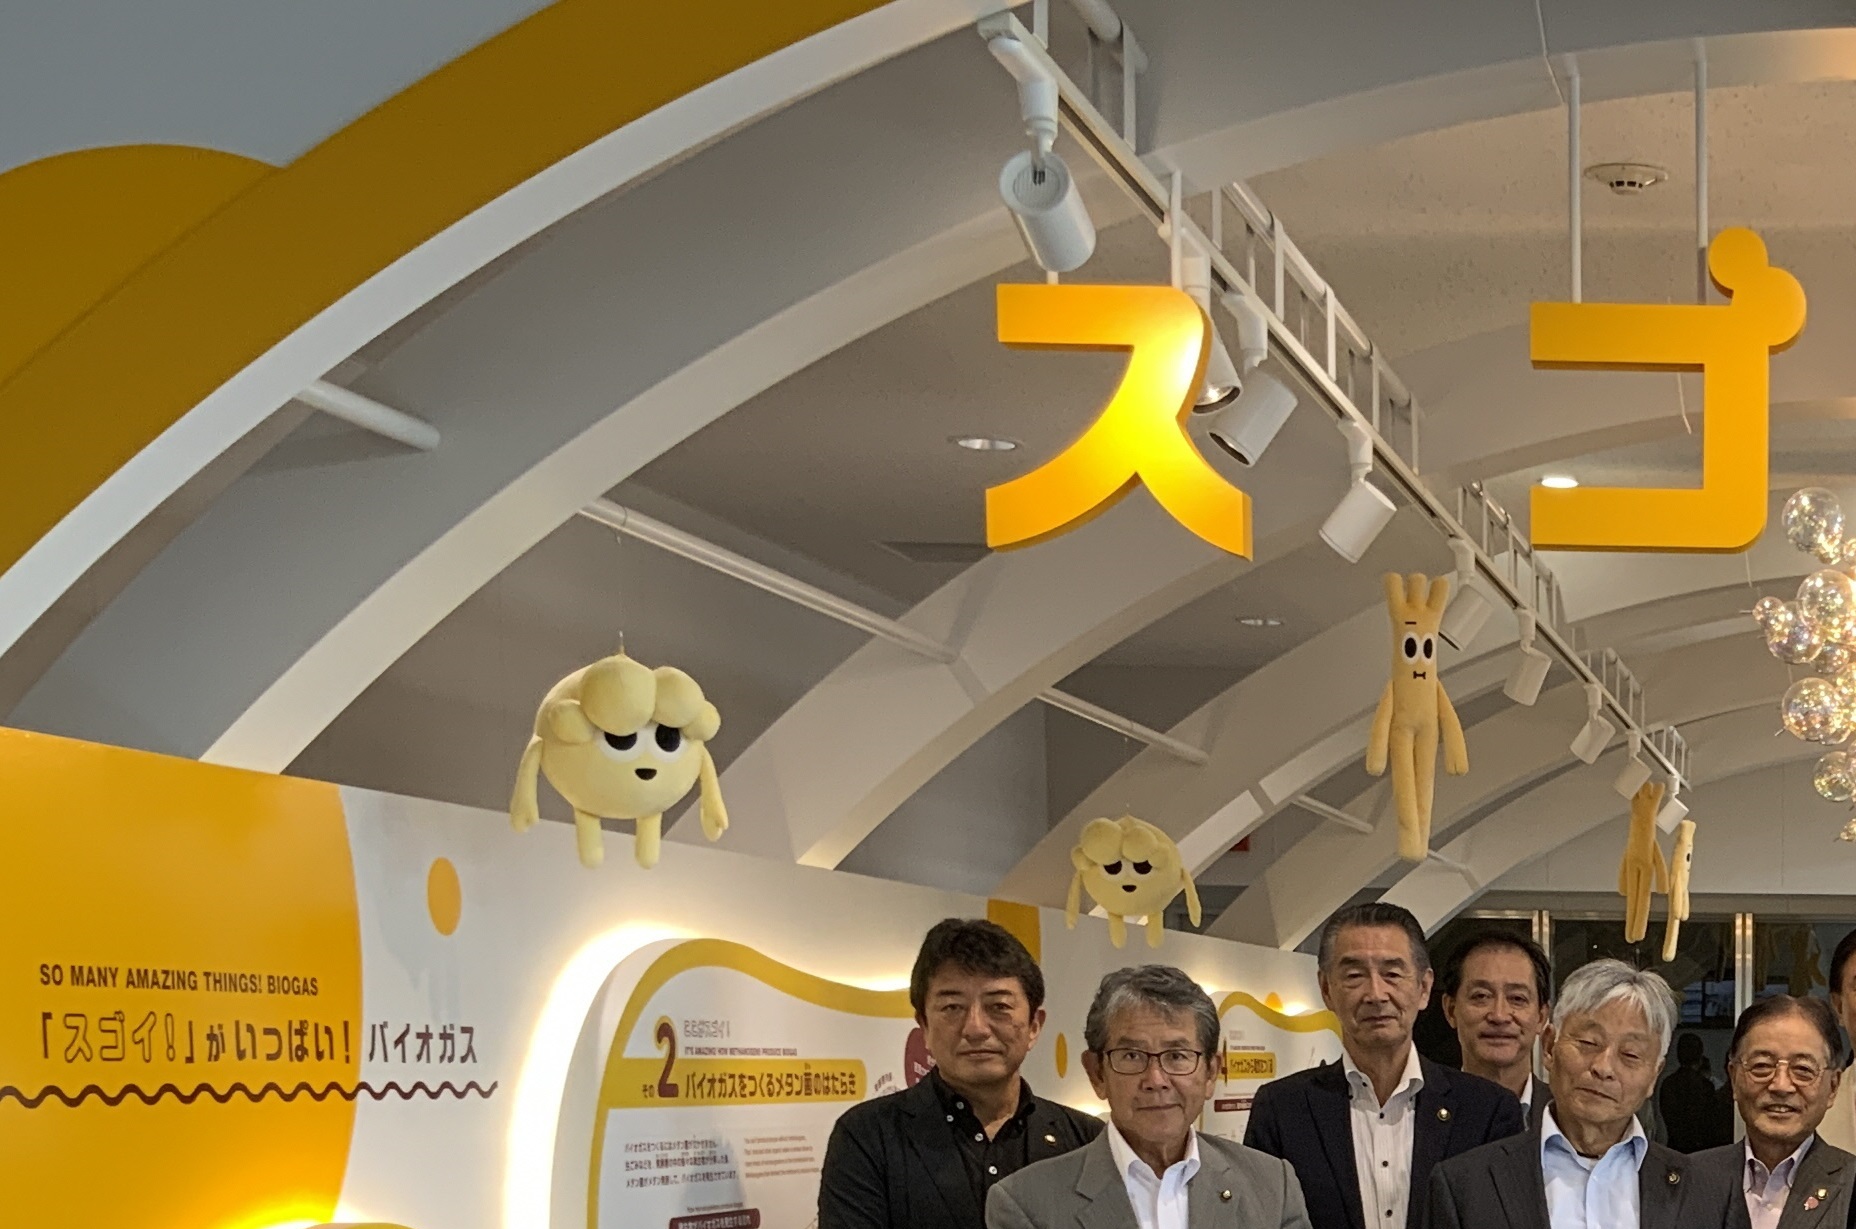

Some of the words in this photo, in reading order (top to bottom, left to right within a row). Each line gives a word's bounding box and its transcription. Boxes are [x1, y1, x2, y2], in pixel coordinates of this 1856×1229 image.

[39, 963, 64, 986] SO
[70, 965, 119, 988] MANY
[125, 968, 198, 991] AMAZING
[203, 971, 262, 994] THINGS!
[267, 974, 318, 996] BIOGAS
[368, 1020, 478, 1064] バイオガス
[642, 1084, 655, 1099] その
[656, 1022, 679, 1098] 2
[685, 1071, 857, 1098] バイオガスをつくるメタン菌のはたらき
